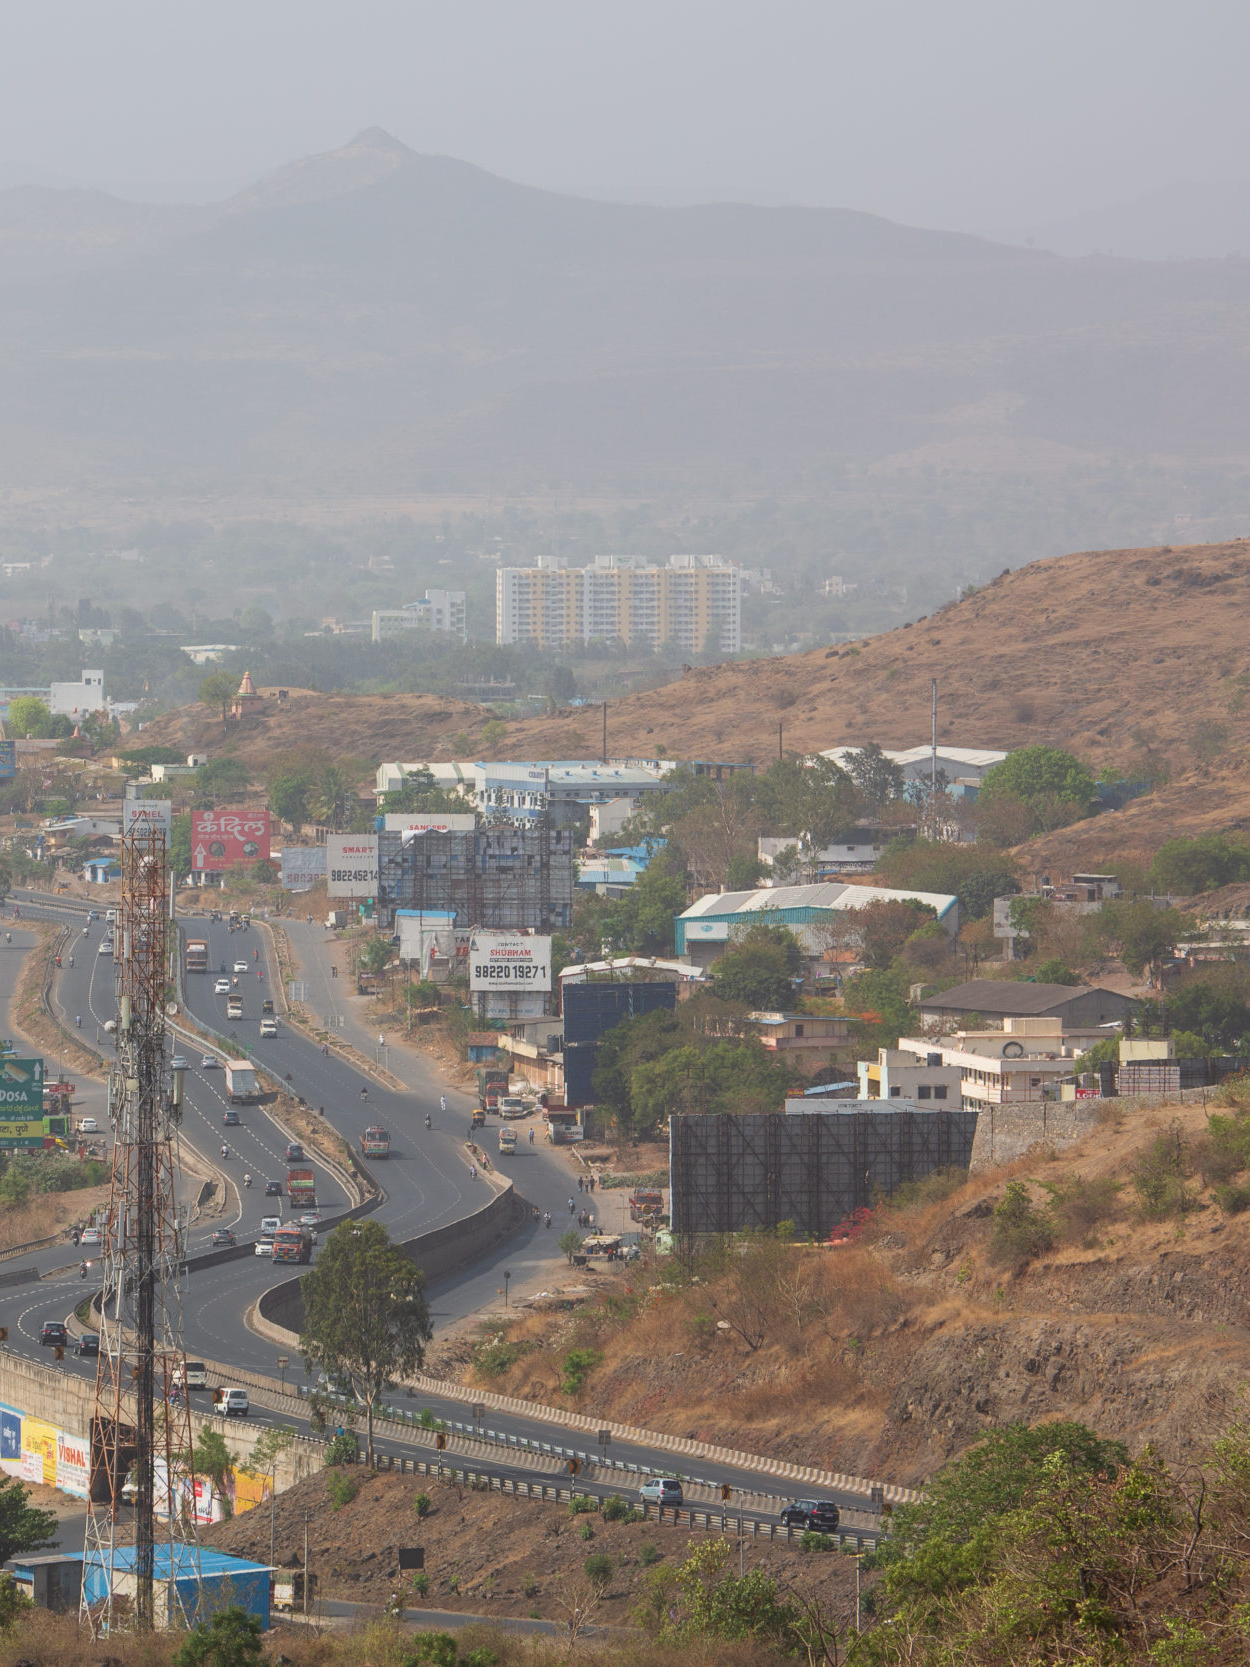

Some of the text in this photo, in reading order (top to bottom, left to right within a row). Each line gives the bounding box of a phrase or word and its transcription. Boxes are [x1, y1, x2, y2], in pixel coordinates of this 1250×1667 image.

[342, 846, 375, 854] SMART
[489, 949, 532, 957] SHUBHAM
[58, 1443, 86, 1468] VISHAL
